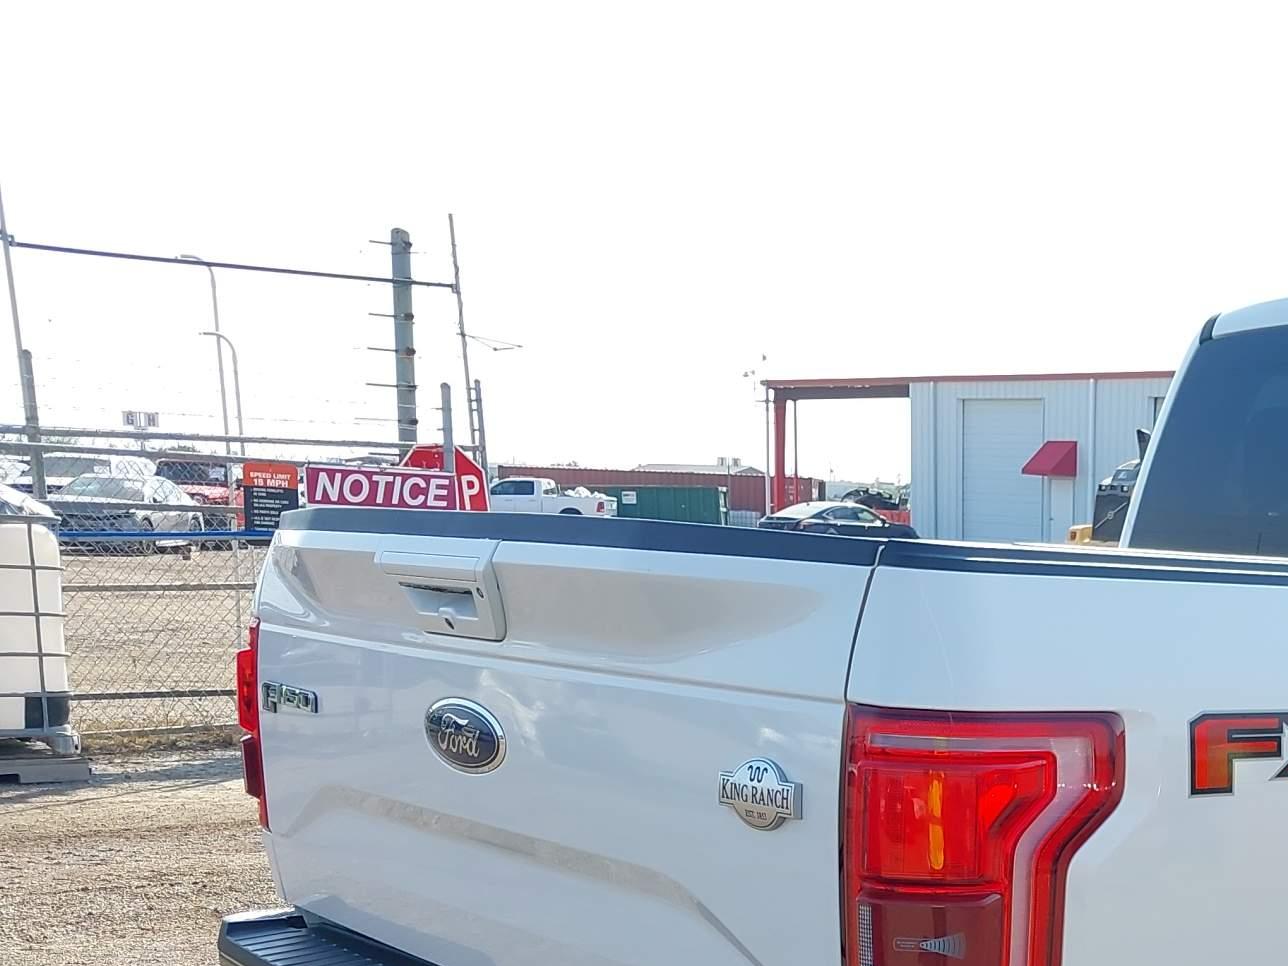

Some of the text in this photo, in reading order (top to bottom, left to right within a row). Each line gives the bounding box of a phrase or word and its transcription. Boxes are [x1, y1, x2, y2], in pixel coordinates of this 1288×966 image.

[266, 480, 289, 488] MPH
[315, 471, 449, 507] NOTICE
[437, 713, 480, 758] Ford
[751, 785, 790, 810] RANCH
